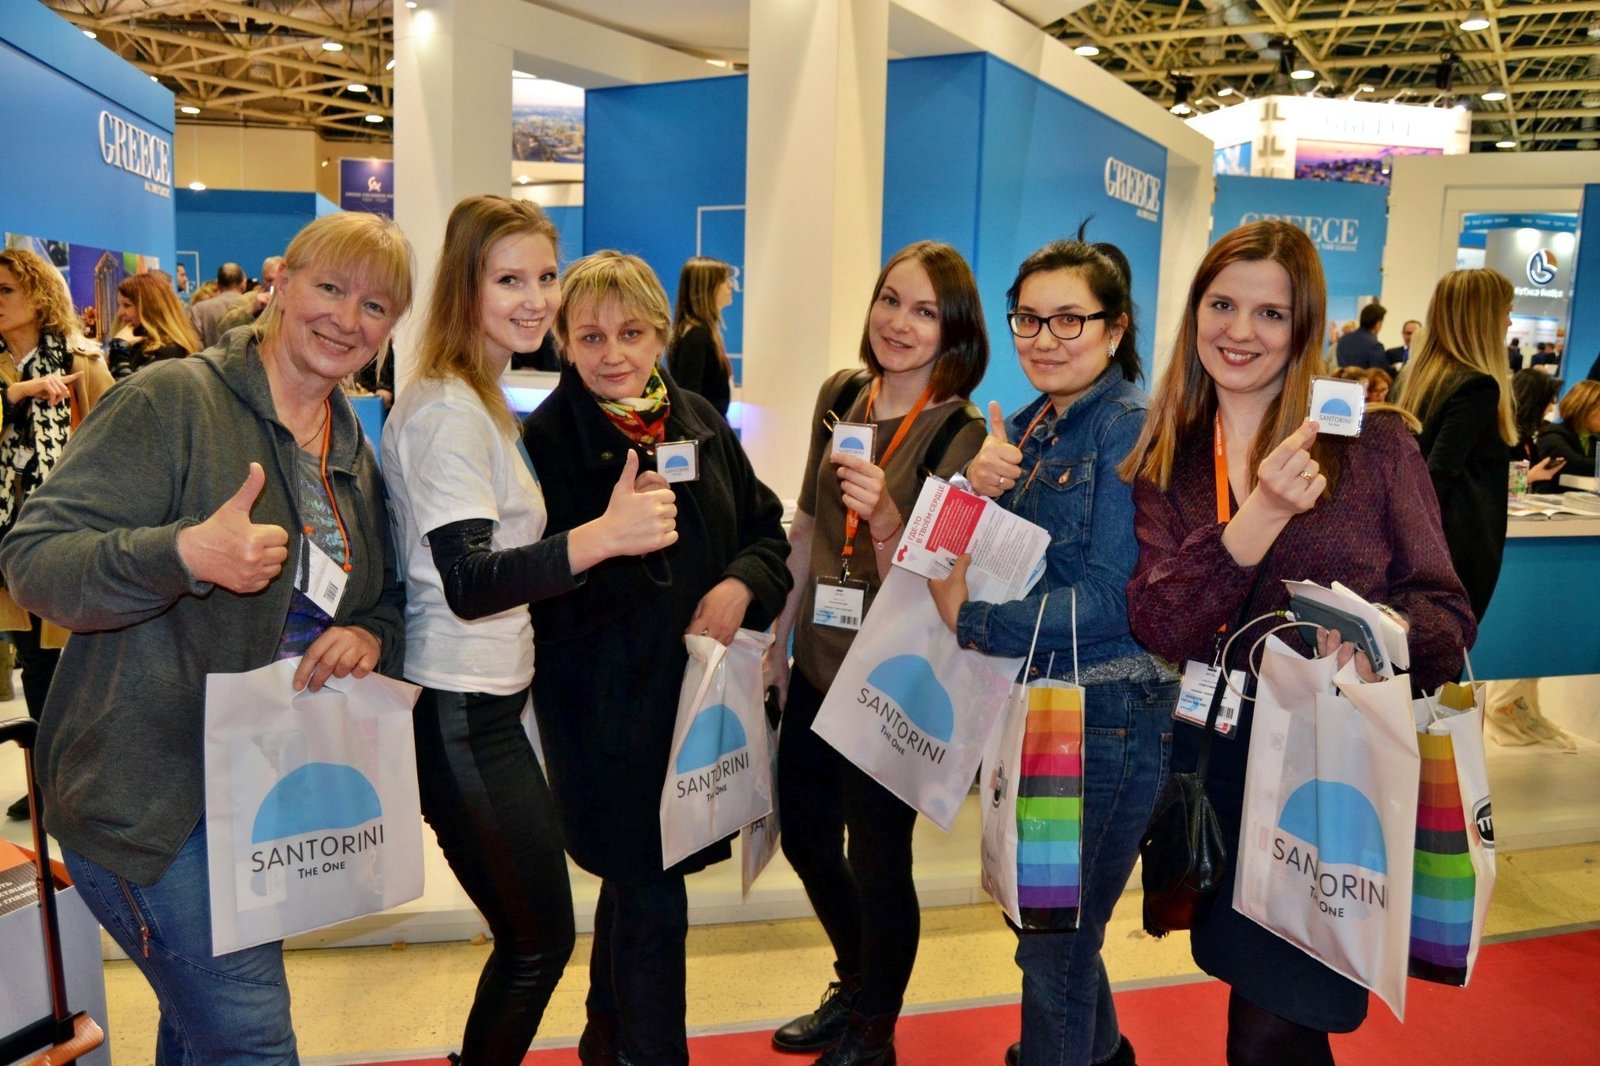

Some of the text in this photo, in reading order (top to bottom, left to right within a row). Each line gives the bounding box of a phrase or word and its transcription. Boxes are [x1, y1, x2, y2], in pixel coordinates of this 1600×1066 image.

[99, 110, 170, 187] GREECE
[1104, 156, 1160, 212] GREECE
[1239, 211, 1359, 244] ECE
[908, 515, 922, 541] ГДЕ-ТО
[857, 687, 946, 765] SANTORINI
[880, 725, 905, 755] THE ONE
[676, 752, 749, 798] SANTORINI
[715, 784, 727, 795] ONE
[251, 824, 384, 873] SANTORINI
[298, 861, 346, 879] THE ONE
[1319, 901, 1344, 918] ONE
